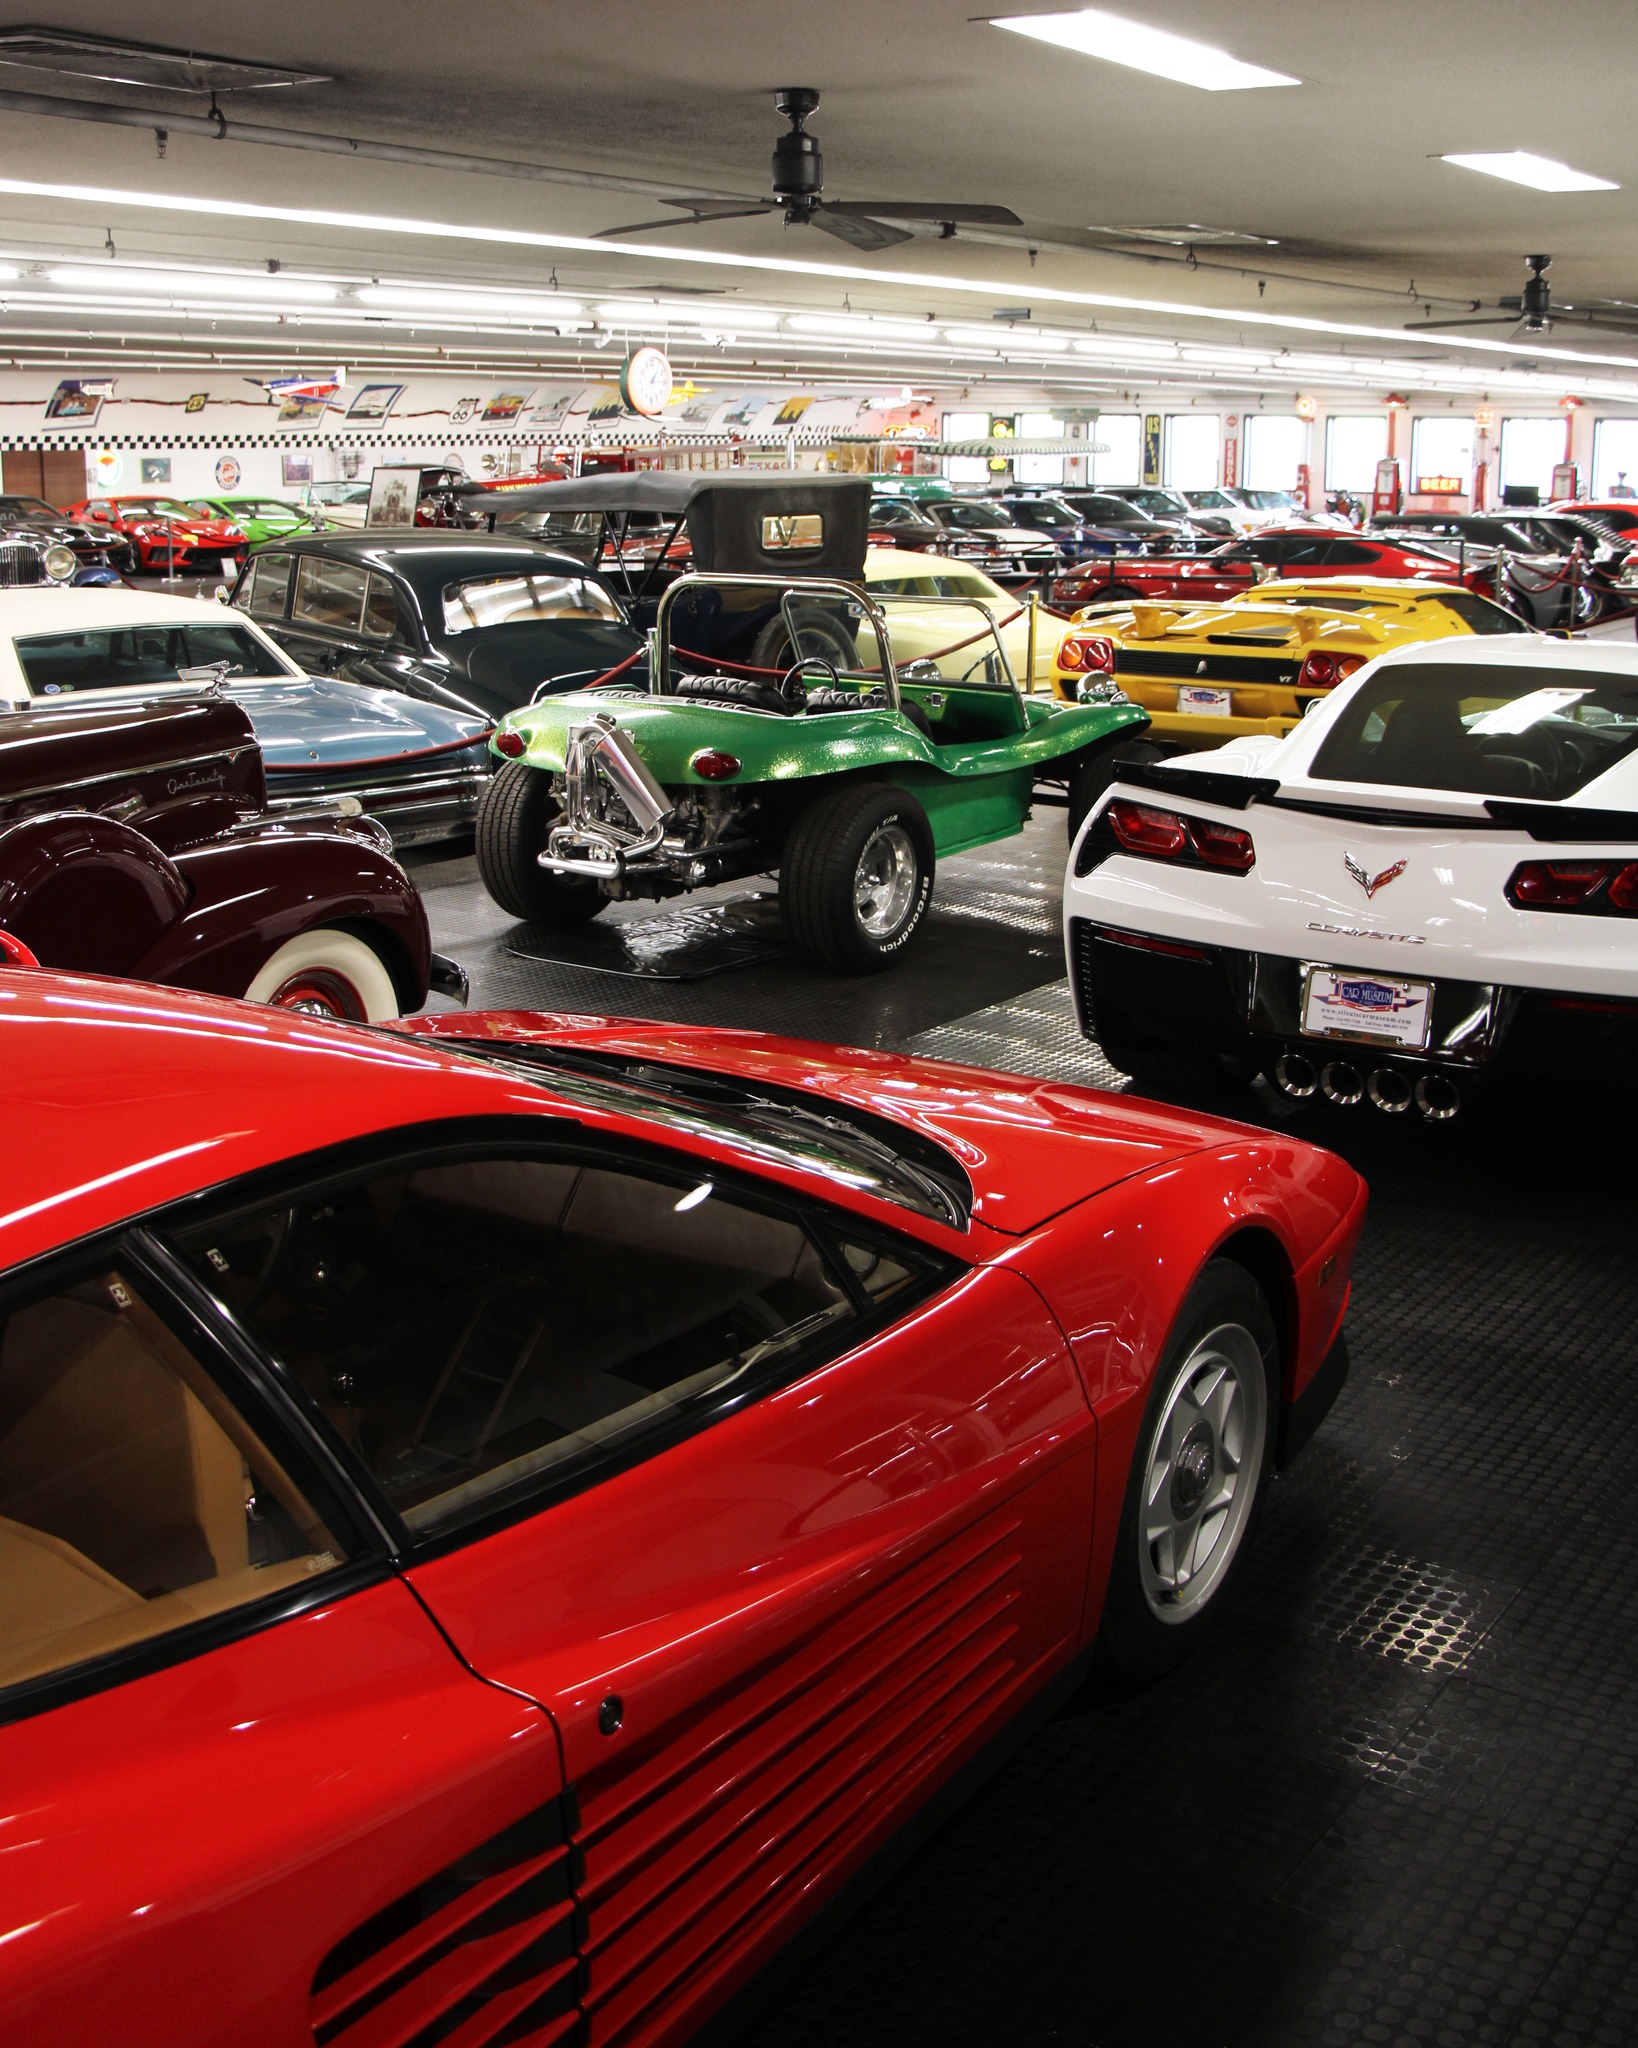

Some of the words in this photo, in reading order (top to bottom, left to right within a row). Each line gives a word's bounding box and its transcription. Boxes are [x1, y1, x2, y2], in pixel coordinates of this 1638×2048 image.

[452, 411, 468, 420] 66
[1146, 416, 1159, 433] US
[1420, 478, 1459, 490] BEER
[883, 814, 898, 826] T/A
[1305, 922, 1427, 944] CORVETTE
[1342, 986, 1360, 999] CAR
[1361, 990, 1393, 1003] MUSEUM
